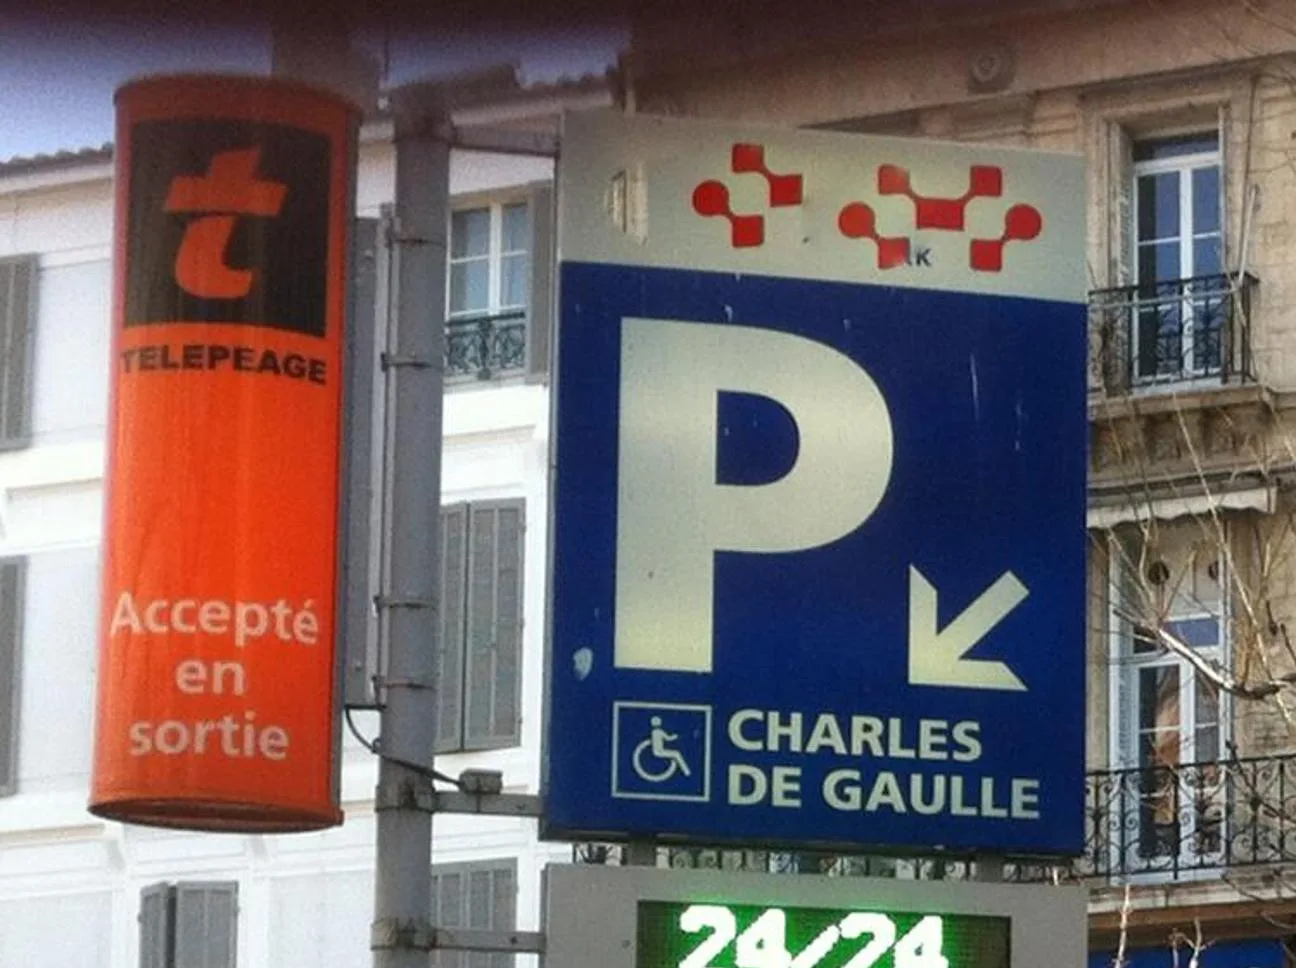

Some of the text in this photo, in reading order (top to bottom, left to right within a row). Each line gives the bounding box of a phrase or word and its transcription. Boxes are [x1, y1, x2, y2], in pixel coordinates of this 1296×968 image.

[120, 346, 327, 386] TELEPEAGE
[614, 317, 893, 672] P
[108, 592, 319, 645] Accepté
[176, 658, 246, 696] en
[129, 711, 289, 760] sortie
[728, 709, 982, 762] CHARLES
[728, 766, 1040, 821] DE GAULLE
